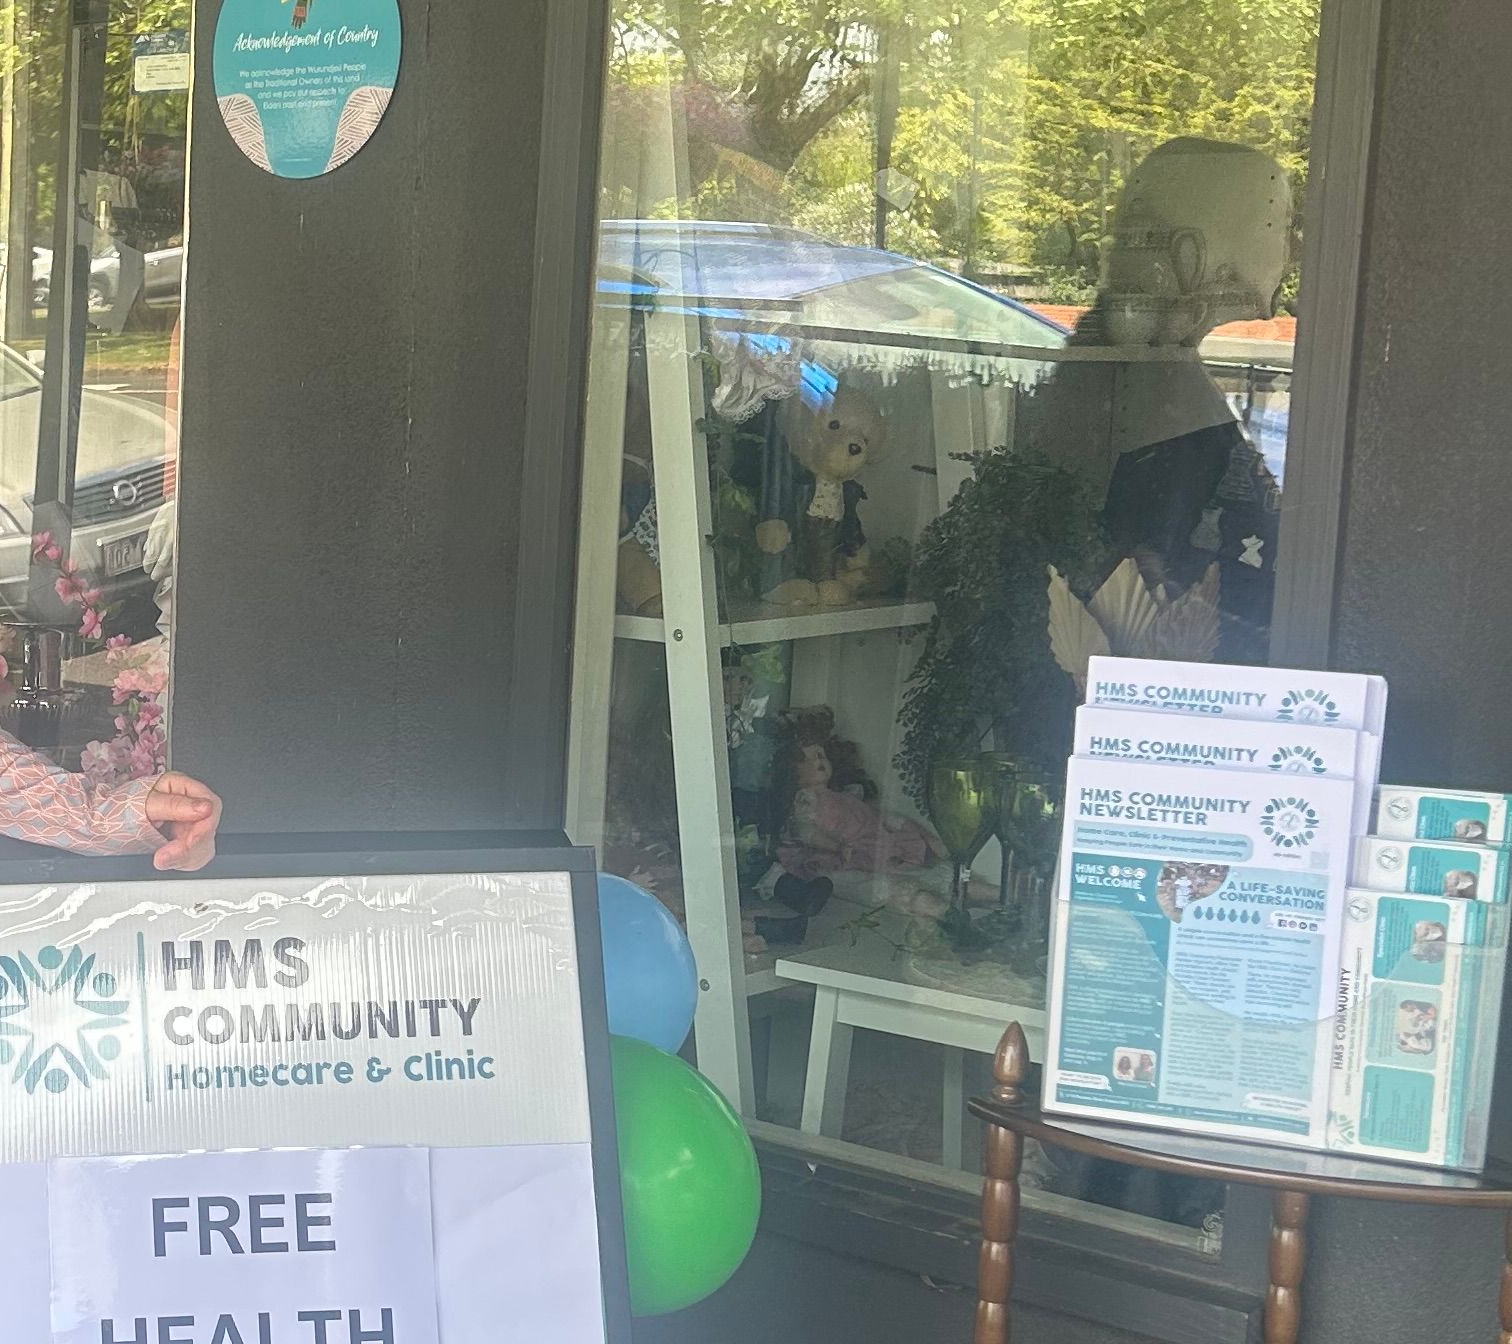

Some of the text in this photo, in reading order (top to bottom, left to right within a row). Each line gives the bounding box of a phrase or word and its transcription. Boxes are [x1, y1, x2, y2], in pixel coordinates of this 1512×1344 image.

[232, 24, 379, 53] Acknowledgement of Country
[1095, 681, 1267, 707] HMS COMMUNITY
[1090, 736, 1131, 752] HMS
[1137, 740, 1259, 763] COMMUNITY
[1080, 787, 1251, 813] HMS COMMUNITY
[1079, 802, 1208, 826] NEWSLETTER
[1074, 873, 1142, 890] WELCOME
[1075, 863, 1105, 875] HMS
[1218, 891, 1325, 912] CONVERSATION
[1227, 880, 1326, 900] A LIFE-SAVING
[161, 936, 309, 991] HMS
[163, 996, 482, 1046] COMMUNITY
[1332, 967, 1352, 1070] HMS COMMUNITY
[166, 1049, 495, 1091] Homecare & Clinic
[151, 1193, 337, 1258] FREE
